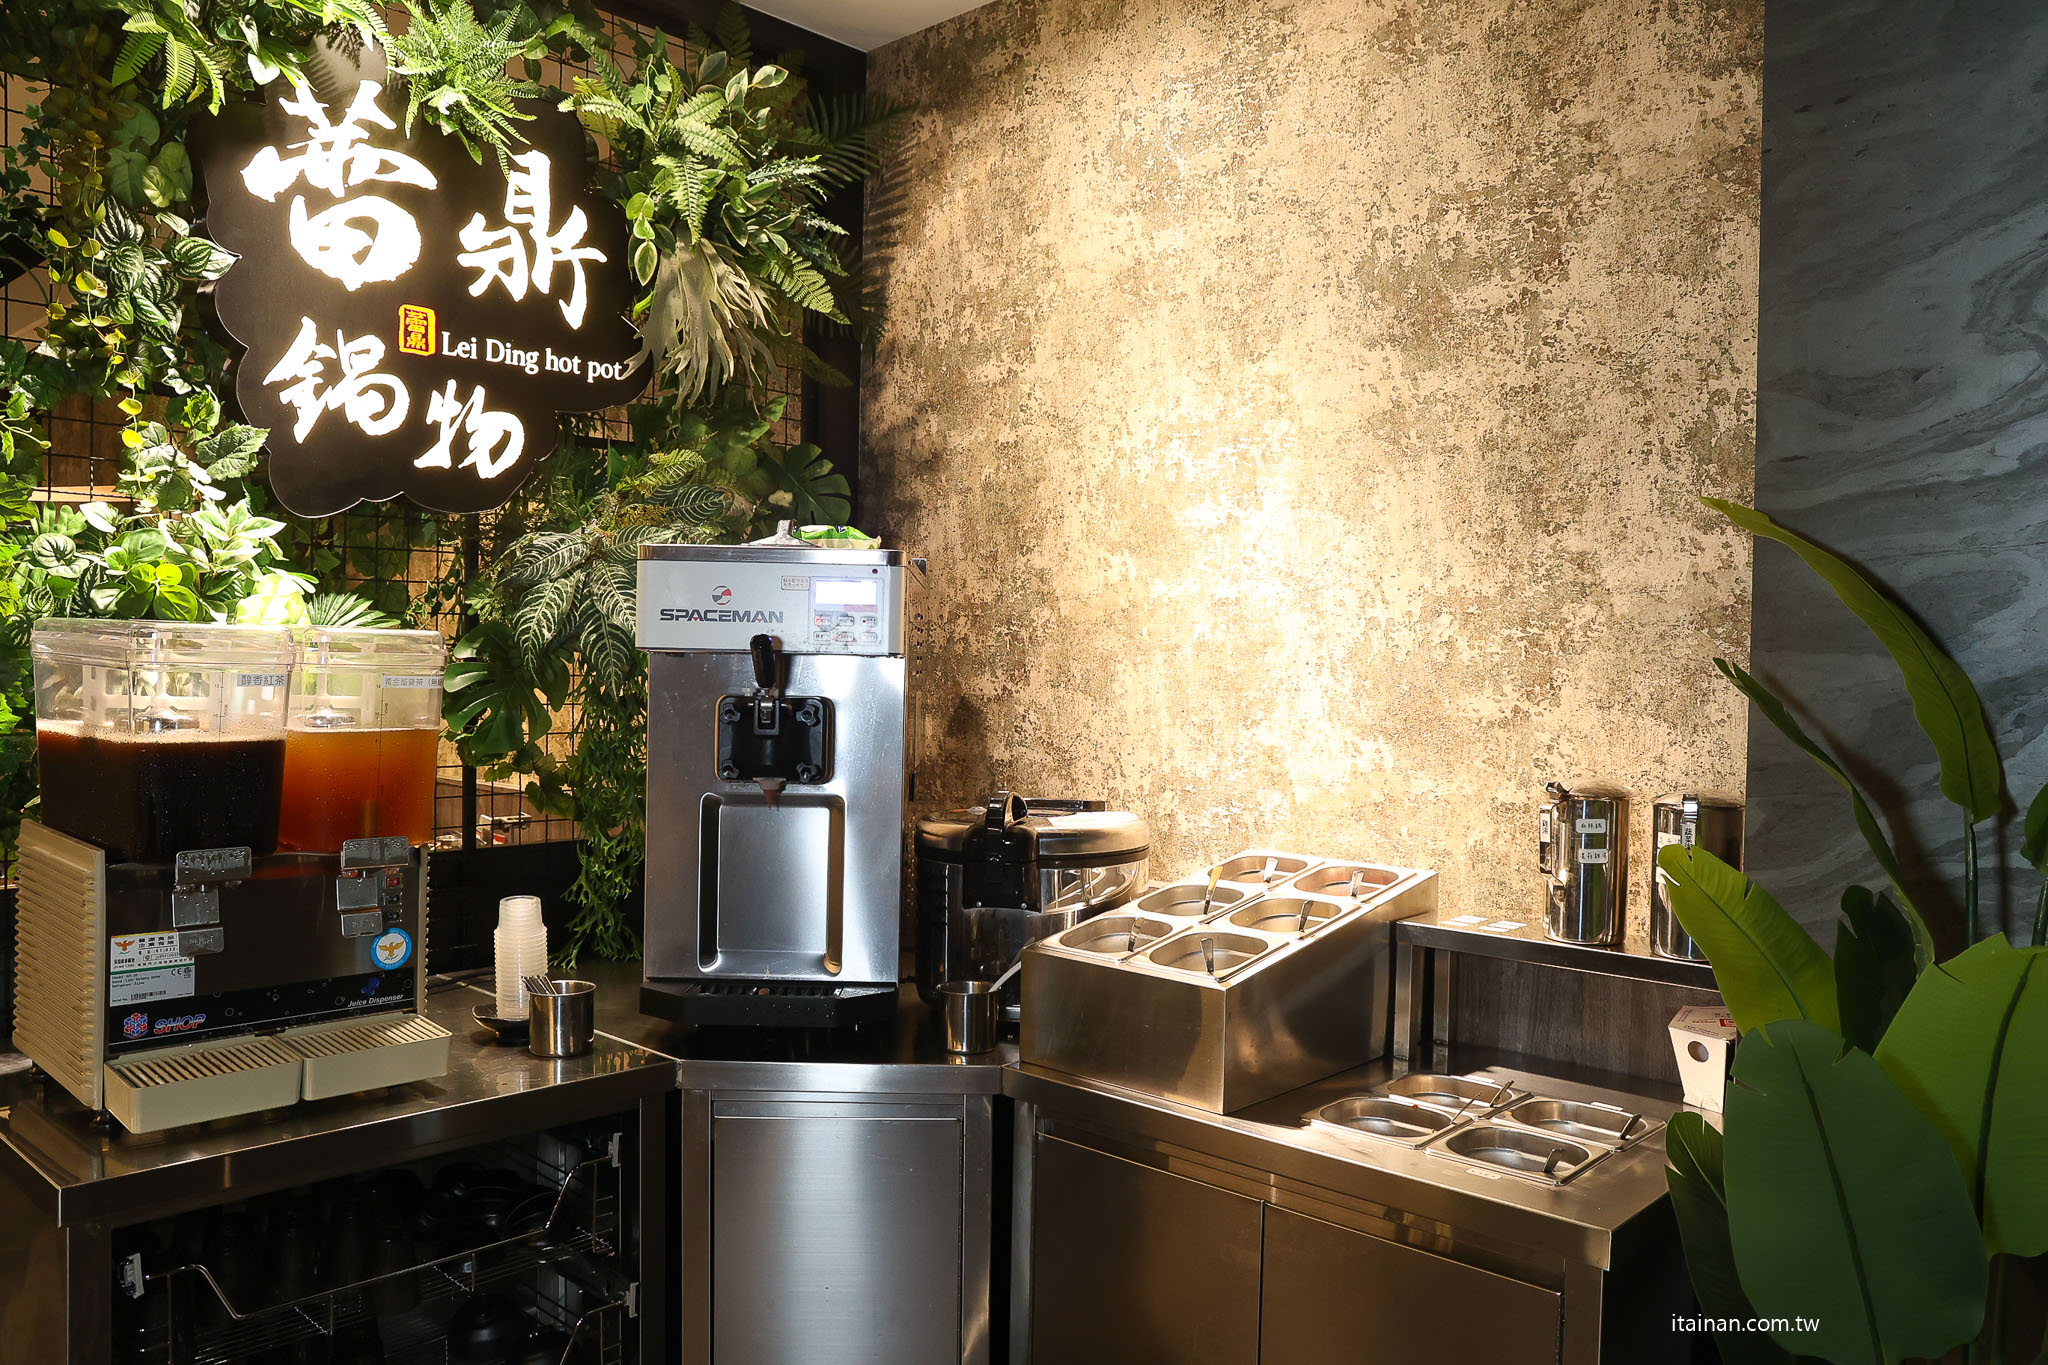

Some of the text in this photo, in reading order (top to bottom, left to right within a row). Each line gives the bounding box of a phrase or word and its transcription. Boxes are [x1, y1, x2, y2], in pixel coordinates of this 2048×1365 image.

[441, 331, 622, 383] Lei Ding hot pot
[263, 315, 526, 481] 鍋物
[660, 608, 784, 624] SPACEMAN
[347, 994, 404, 1007] Juice Dispenser
[153, 1013, 206, 1034] SHOP
